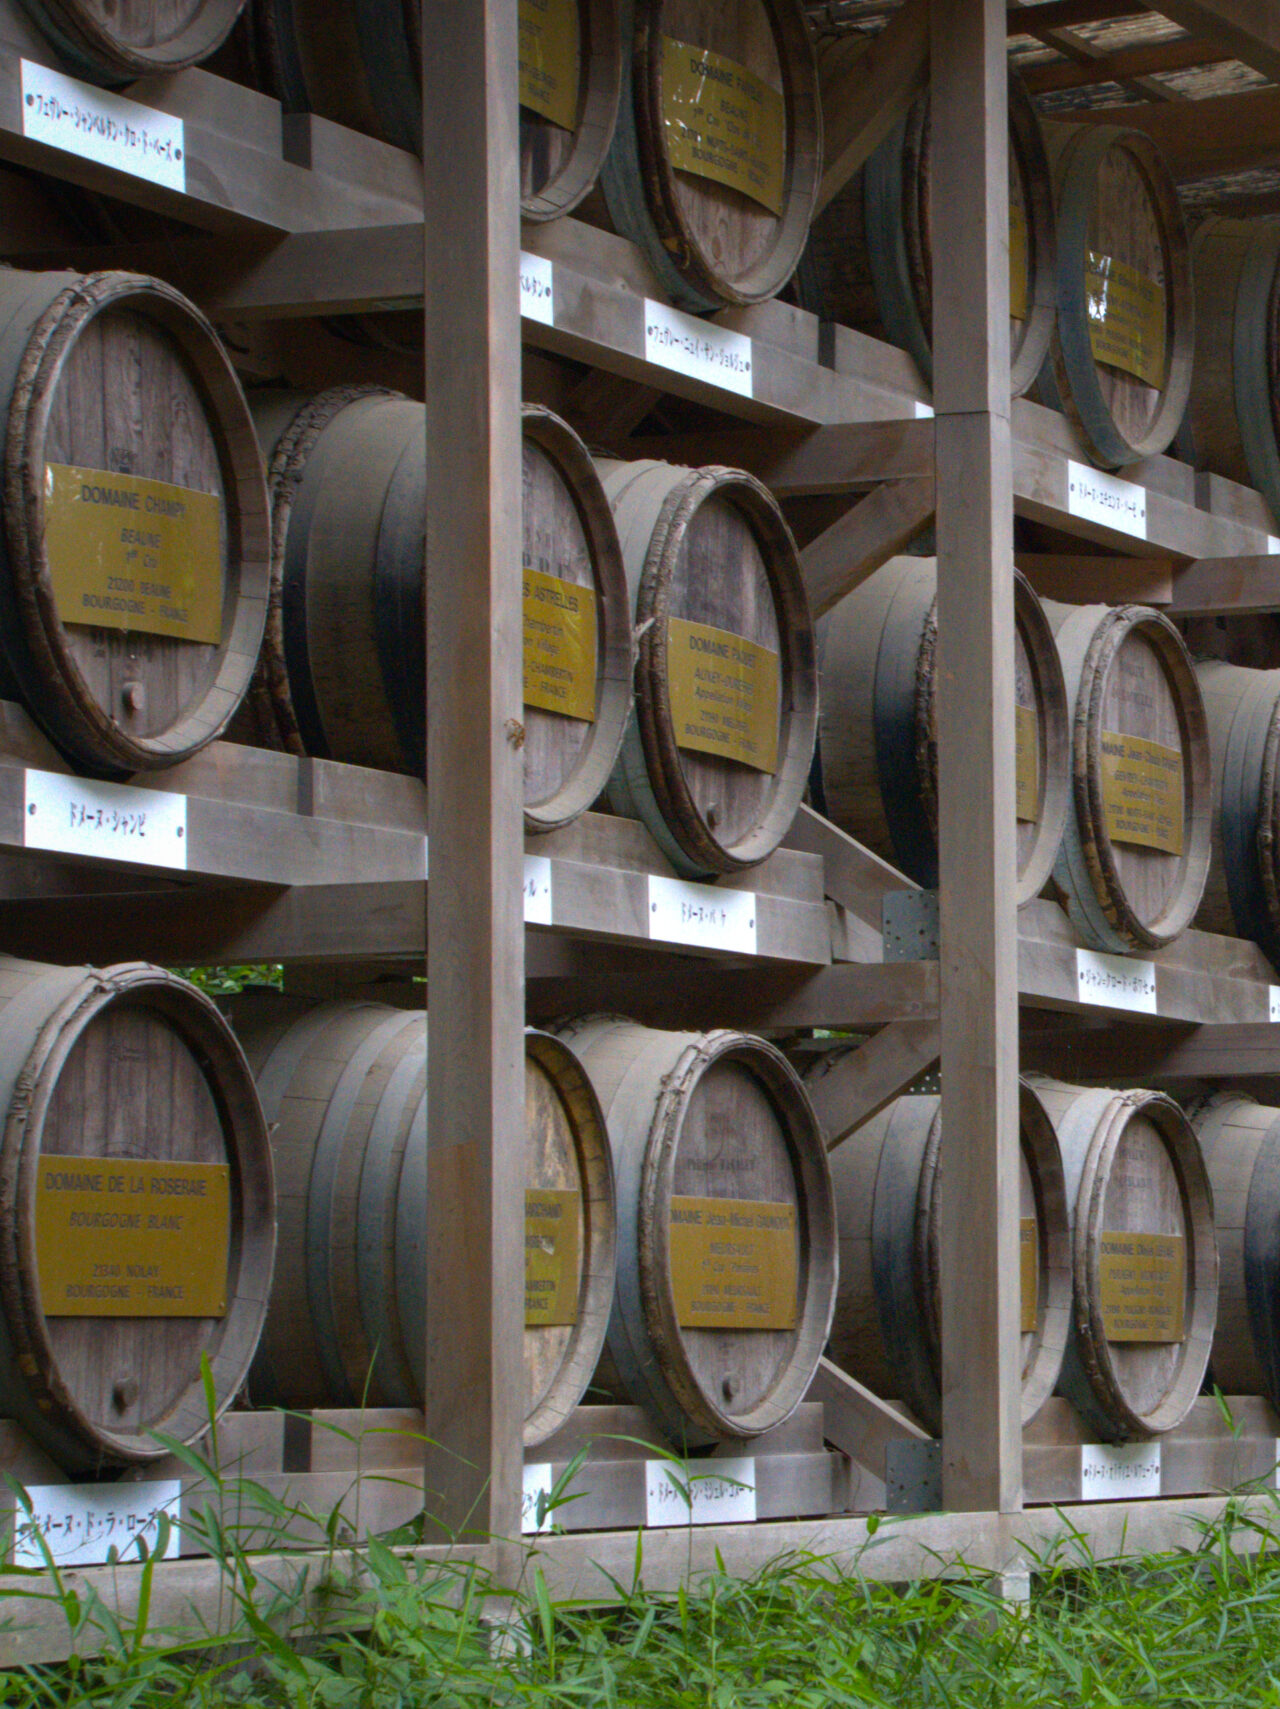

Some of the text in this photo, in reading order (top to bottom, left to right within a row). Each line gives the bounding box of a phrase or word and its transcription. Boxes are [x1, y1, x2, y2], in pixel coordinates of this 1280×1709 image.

[81, 485, 187, 519] DOMAINE CHAMPY
[120, 528, 162, 549] BEAUNE
[140, 581, 172, 599] BEAUNE
[82, 593, 145, 615] BOURGOGNE
[160, 604, 189, 623] FRANCE
[689, 635, 730, 659] DOMAINE
[45, 1172, 207, 1196] DOMAINE DE LA ROSERAIE
[69, 1211, 184, 1230] BOURGOGNE BLANC
[126, 1264, 161, 1279] NOLAY
[65, 1284, 131, 1299] BOURGOGNE
[147, 1285, 184, 1300] FRANCE
